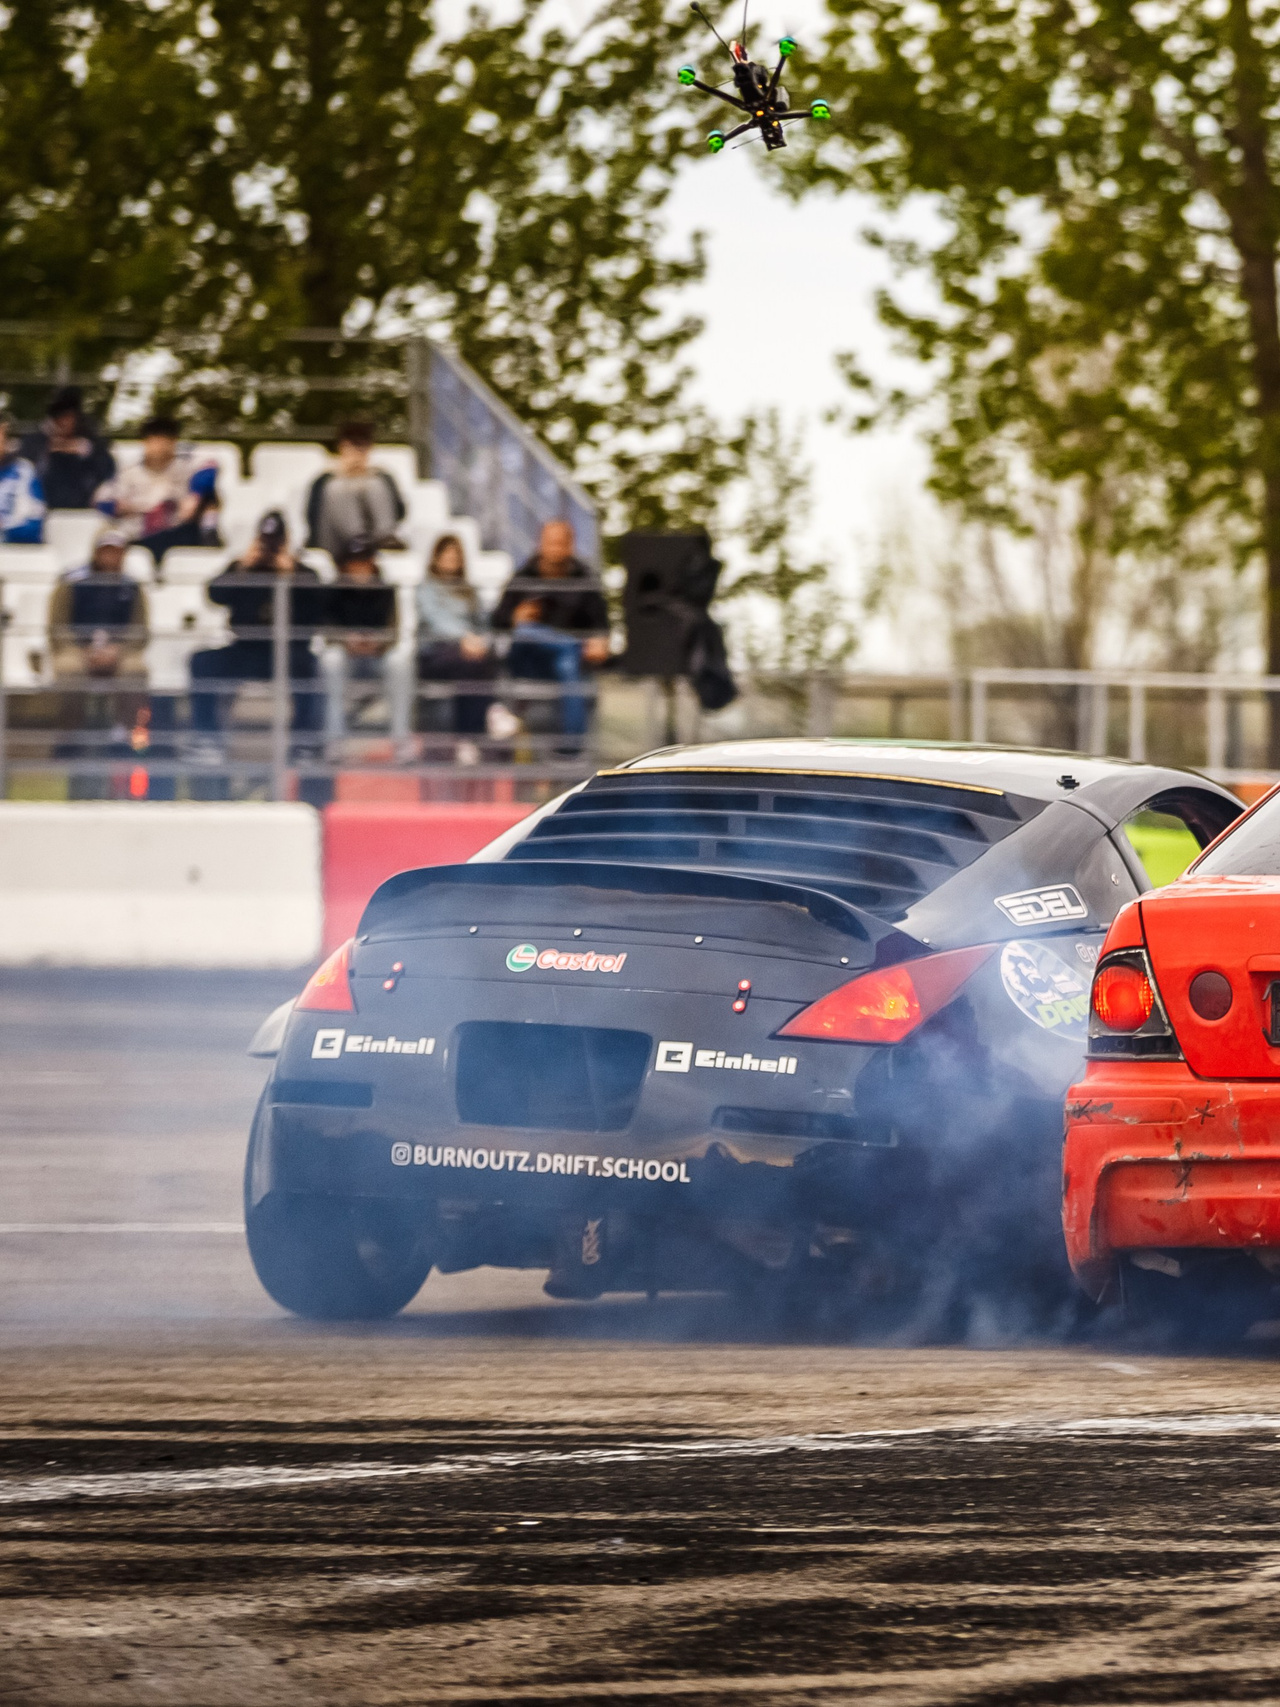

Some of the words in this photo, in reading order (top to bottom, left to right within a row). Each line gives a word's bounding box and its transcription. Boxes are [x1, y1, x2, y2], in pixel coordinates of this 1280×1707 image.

[1000, 890, 1084, 922] EDEL
[537, 948, 627, 973] Castrol
[345, 1034, 436, 1055] Einhell
[694, 1049, 798, 1075] Einhell
[413, 1144, 691, 1183] BURNOUTZ.DRIFT.SCHOOL
